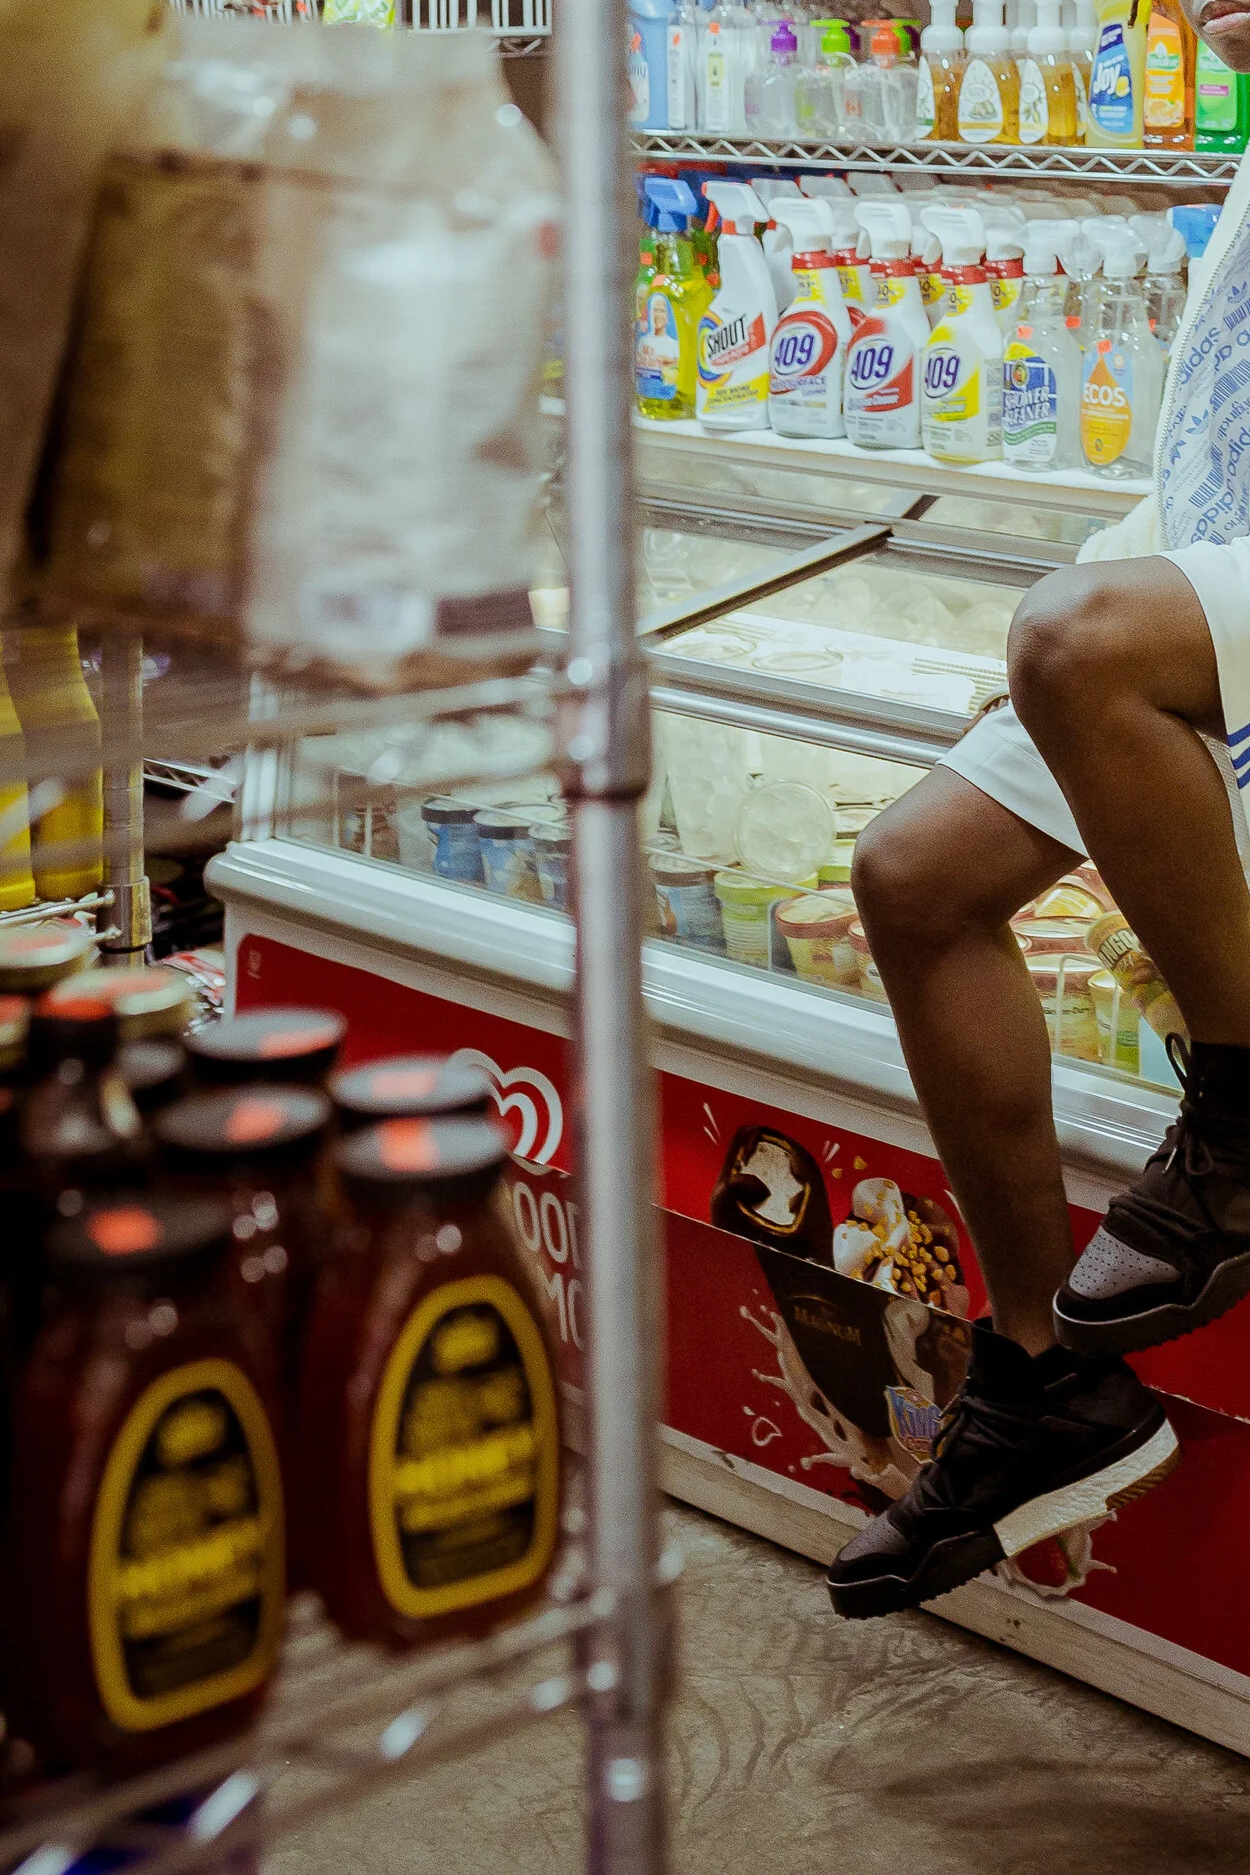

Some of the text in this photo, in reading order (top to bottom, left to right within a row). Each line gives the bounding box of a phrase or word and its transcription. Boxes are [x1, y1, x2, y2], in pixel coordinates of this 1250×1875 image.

[1093, 61, 1122, 96] Joy
[706, 313, 746, 358] SHOUT
[1083, 382, 1127, 407] ECOS
